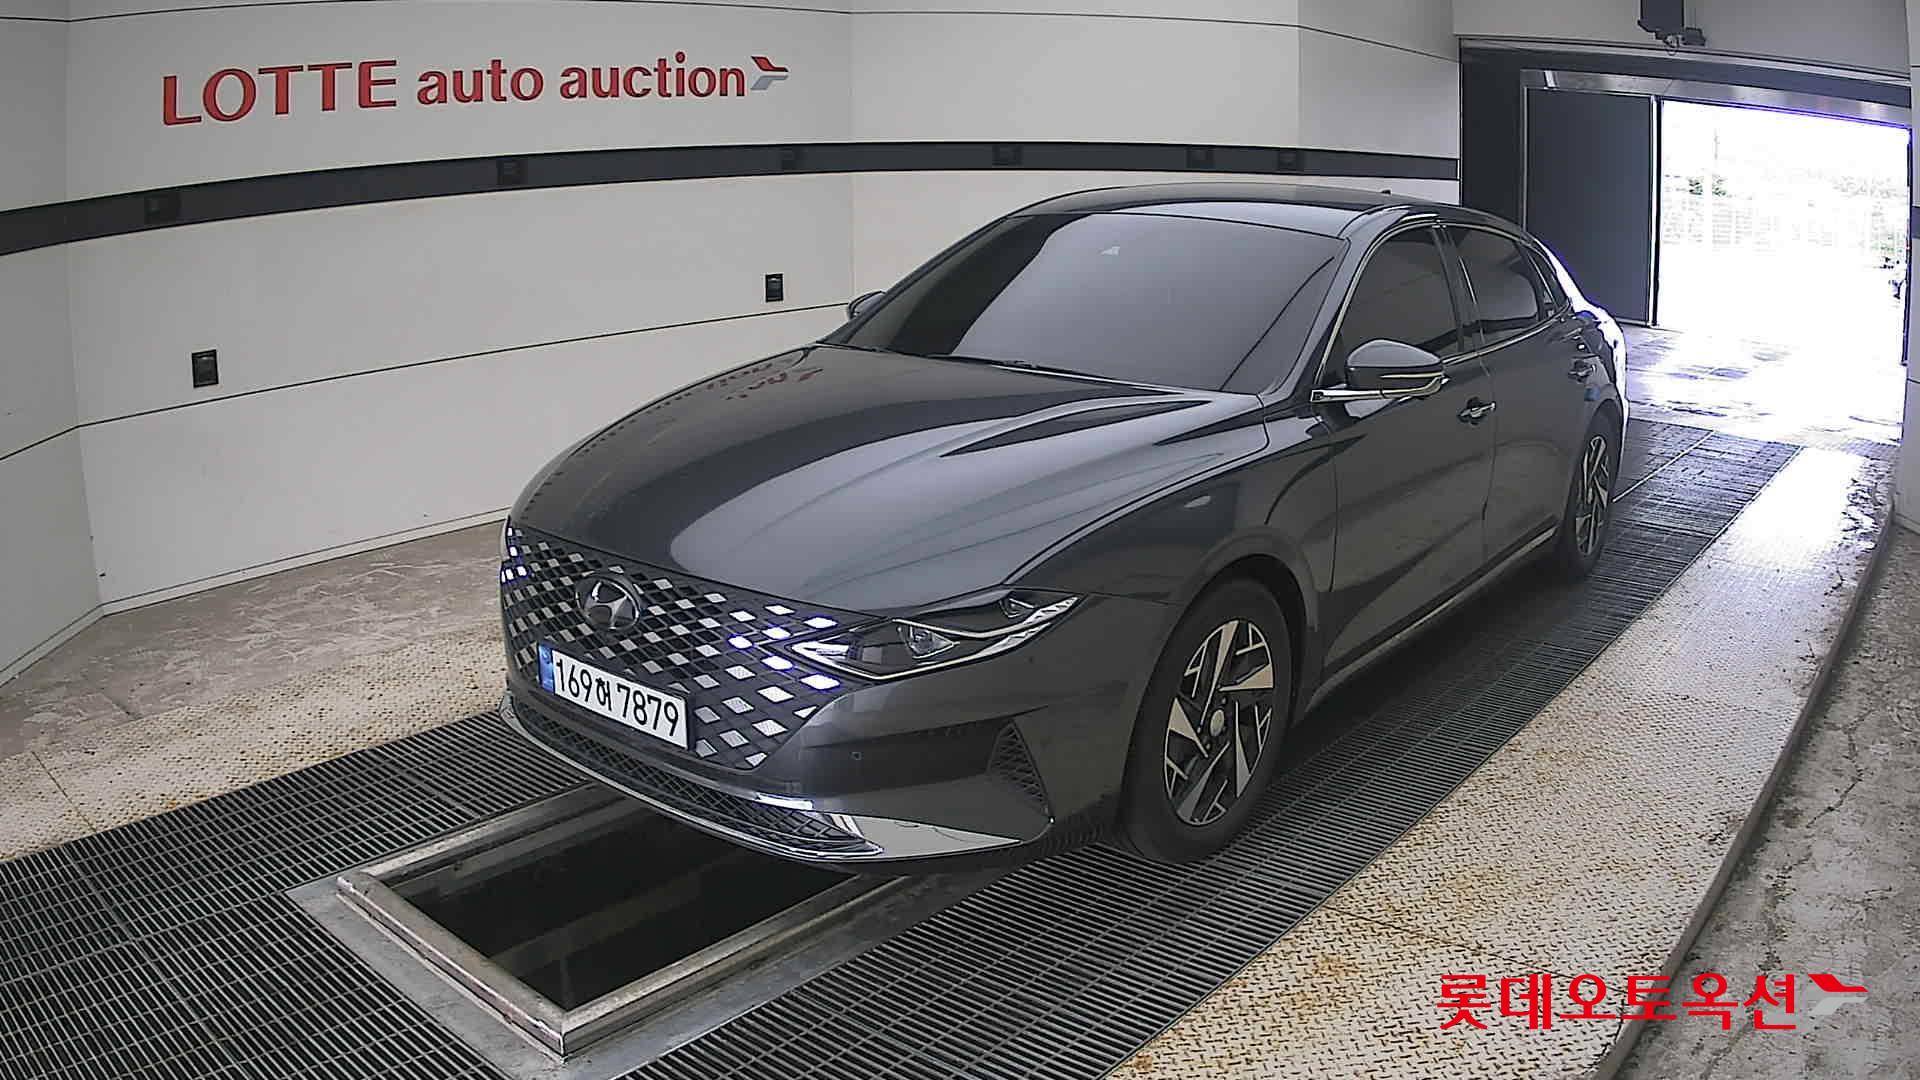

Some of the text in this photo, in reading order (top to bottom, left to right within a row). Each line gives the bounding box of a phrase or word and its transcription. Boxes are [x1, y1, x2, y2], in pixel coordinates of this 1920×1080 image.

[162, 51, 746, 126] LOTTE auto auction
[616, 682, 679, 737] 7879
